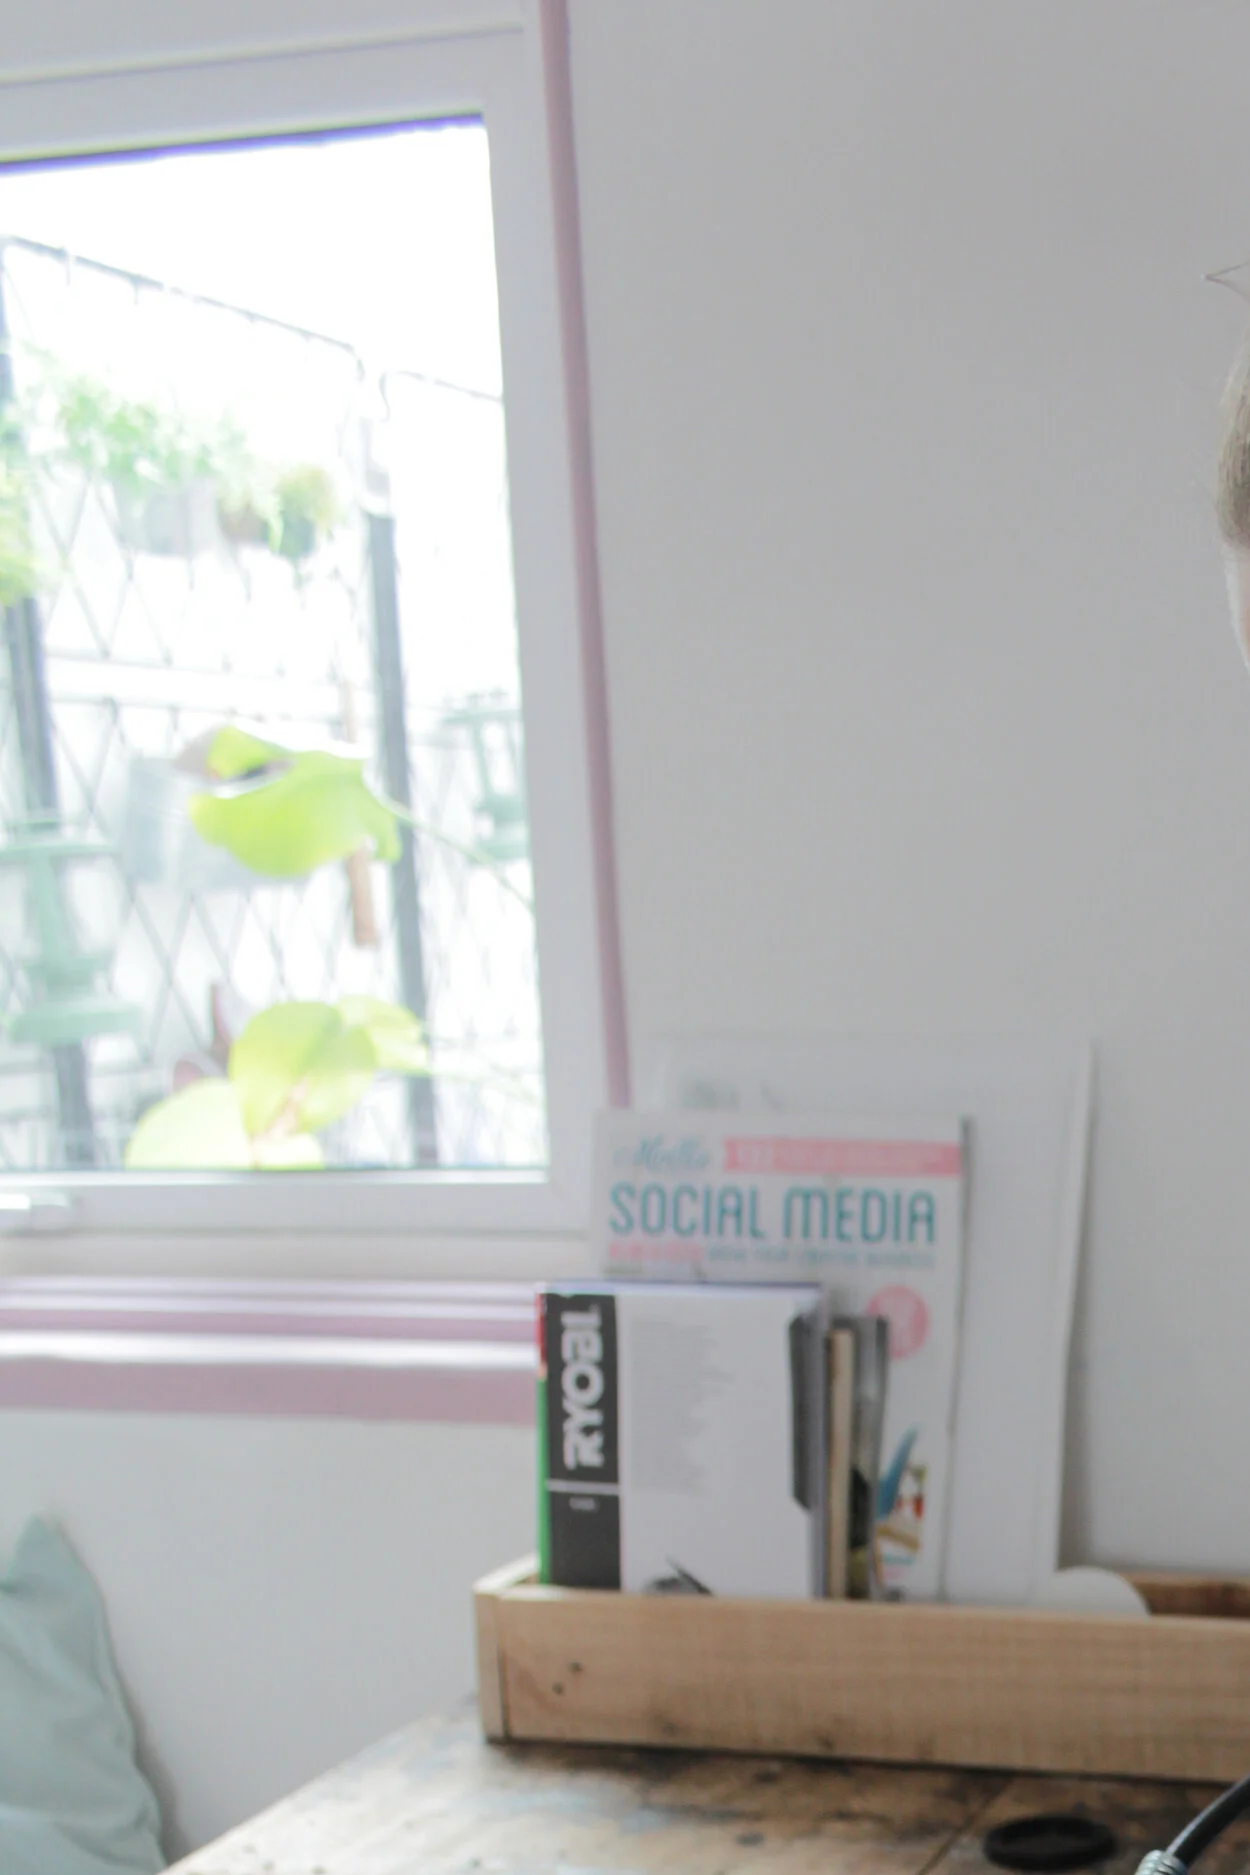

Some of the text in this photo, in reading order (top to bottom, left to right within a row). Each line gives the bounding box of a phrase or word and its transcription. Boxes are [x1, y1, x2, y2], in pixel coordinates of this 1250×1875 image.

[608, 1181, 936, 1244] SOCIAL MEDIA
[560, 1310, 604, 1471] RYOBI
